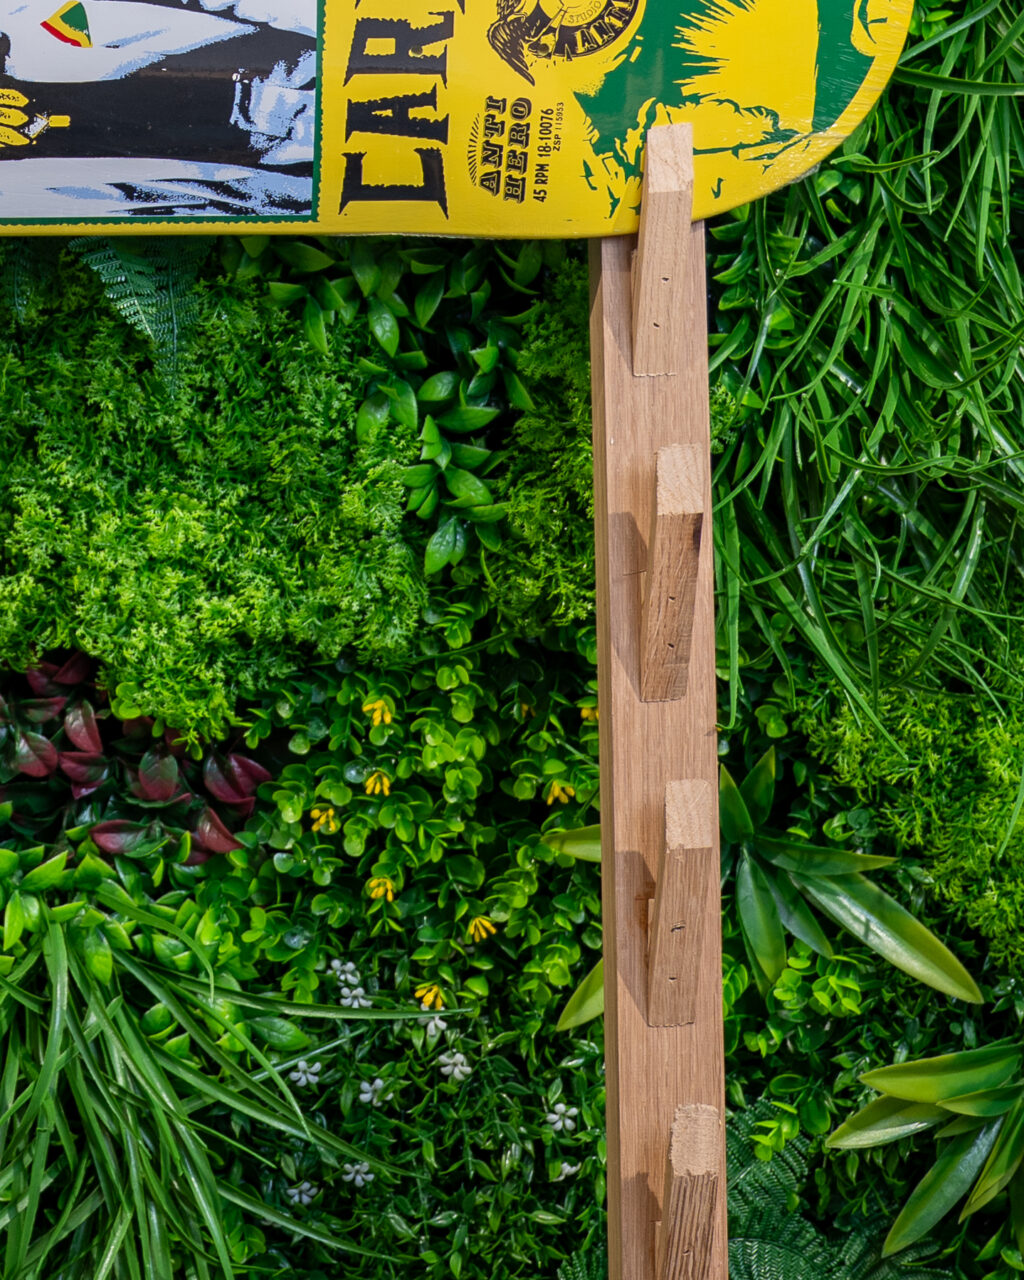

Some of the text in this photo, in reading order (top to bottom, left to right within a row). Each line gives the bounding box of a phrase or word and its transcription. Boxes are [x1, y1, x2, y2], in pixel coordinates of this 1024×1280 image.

[479, 95, 507, 197] ANTI
[503, 97, 532, 204] HERO
[533, 108, 554, 203] 45 RPM 18-10076
[552, 101, 565, 152] ZSP 115953
